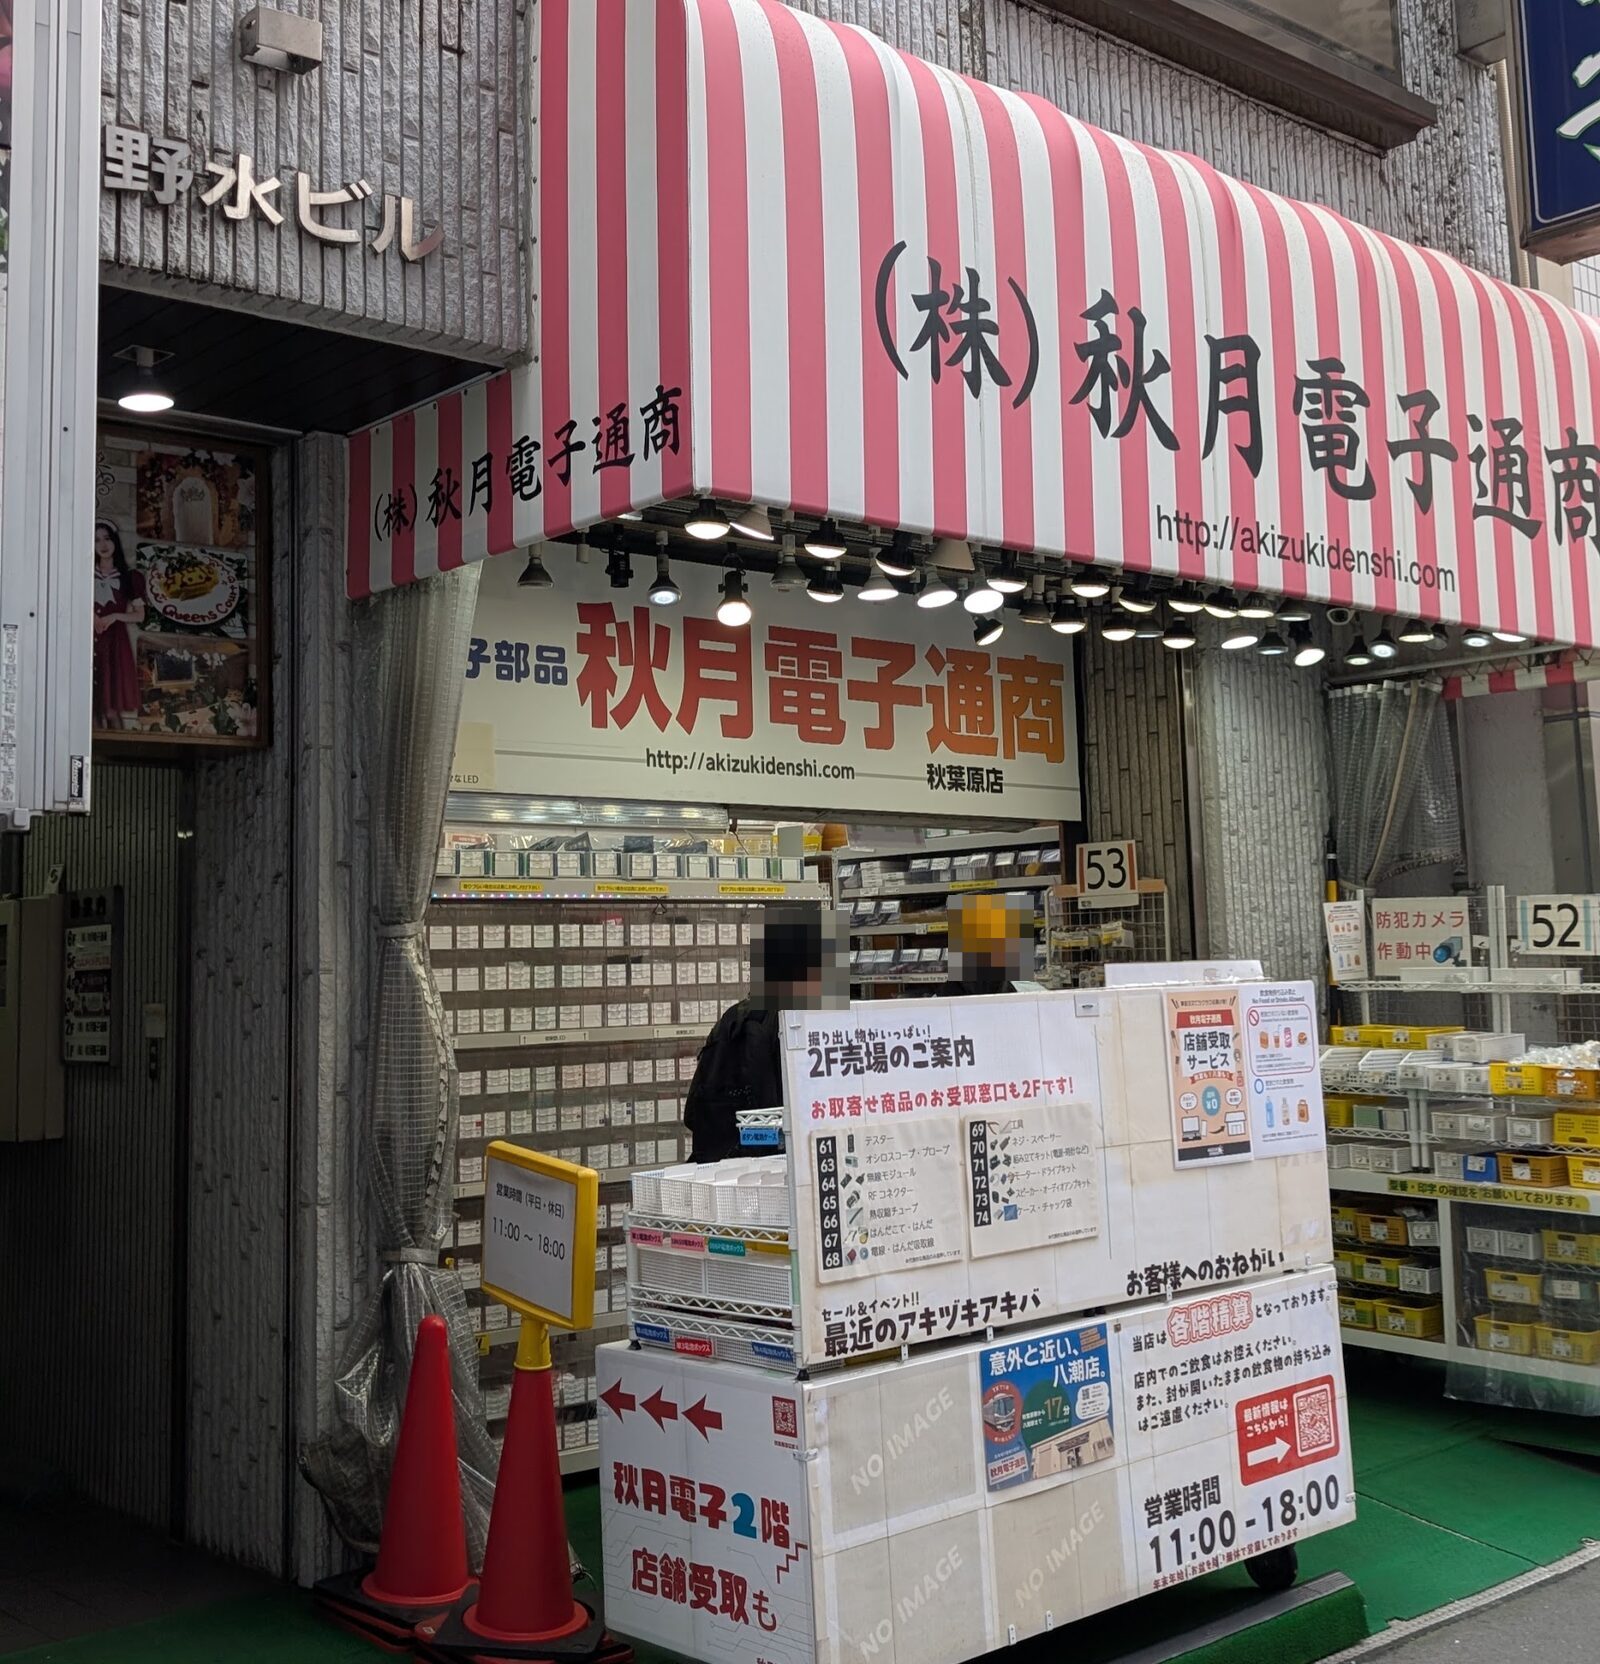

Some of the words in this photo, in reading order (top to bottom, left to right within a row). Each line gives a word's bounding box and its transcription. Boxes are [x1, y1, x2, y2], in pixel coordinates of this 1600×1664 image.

[104, 124, 445, 262] 野水ビル
[1155, 504, 1457, 593] http://akizukidenshi.com
[576, 602, 1065, 763] 秋月電子通商
[646, 748, 856, 780] http://akizukidenshi.com
[926, 763, 1004, 794] 秋葉原店
[1087, 848, 1127, 890] 53
[1376, 911, 1465, 929] 防犯カメラ
[1532, 903, 1581, 948] 52
[1377, 942, 1431, 960] 作動中
[808, 1024, 931, 1046] 掘り出し物がいっぱい!
[1184, 1031, 1231, 1052] 店舗受取
[809, 1036, 975, 1078] 2F売場のご案内
[1187, 1052, 1230, 1070] サービス
[811, 1076, 1074, 1119] お取寄せ商品のお受取窓口も2Fです!
[972, 1123, 984, 1137] 69
[1010, 1119, 1024, 1130] 工具
[819, 1139, 832, 1154] 61
[865, 1134, 895, 1145] テスター
[972, 1141, 985, 1154] 70
[820, 1159, 835, 1173] 63
[821, 1177, 836, 1191] 64
[867, 1168, 917, 1182] 無線モジュール
[973, 1158, 985, 1171] 71
[974, 1177, 987, 1190] 72
[822, 1196, 837, 1210] 65
[975, 1194, 988, 1207] 73
[823, 1215, 838, 1229] 66
[976, 1211, 989, 1224] 74
[492, 1215, 520, 1242] 11:00
[537, 1233, 566, 1261] 18:00
[824, 1234, 839, 1248] 67
[825, 1252, 840, 1267] 68
[1126, 1248, 1285, 1297] お客様へのおねがい
[822, 1290, 920, 1321] セール&イベント!!
[824, 1288, 1041, 1357] 最近のアキヅキアキバ
[989, 1337, 1080, 1376] 意外と近い、
[1053, 1356, 1106, 1388] 八潮店。
[1133, 1334, 1297, 1390] 店内でのご飲食はお控えください。
[1136, 1344, 1331, 1411] また、封が開いたままの飲食物の持ち込み
[1138, 1398, 1230, 1432] はご遠慮ください。
[1243, 1398, 1289, 1422] 最新情報は
[613, 1461, 790, 1549] 秋月電子2階
[1144, 1475, 1222, 1528] 営業時間
[631, 1547, 777, 1633] 店舗受取も
